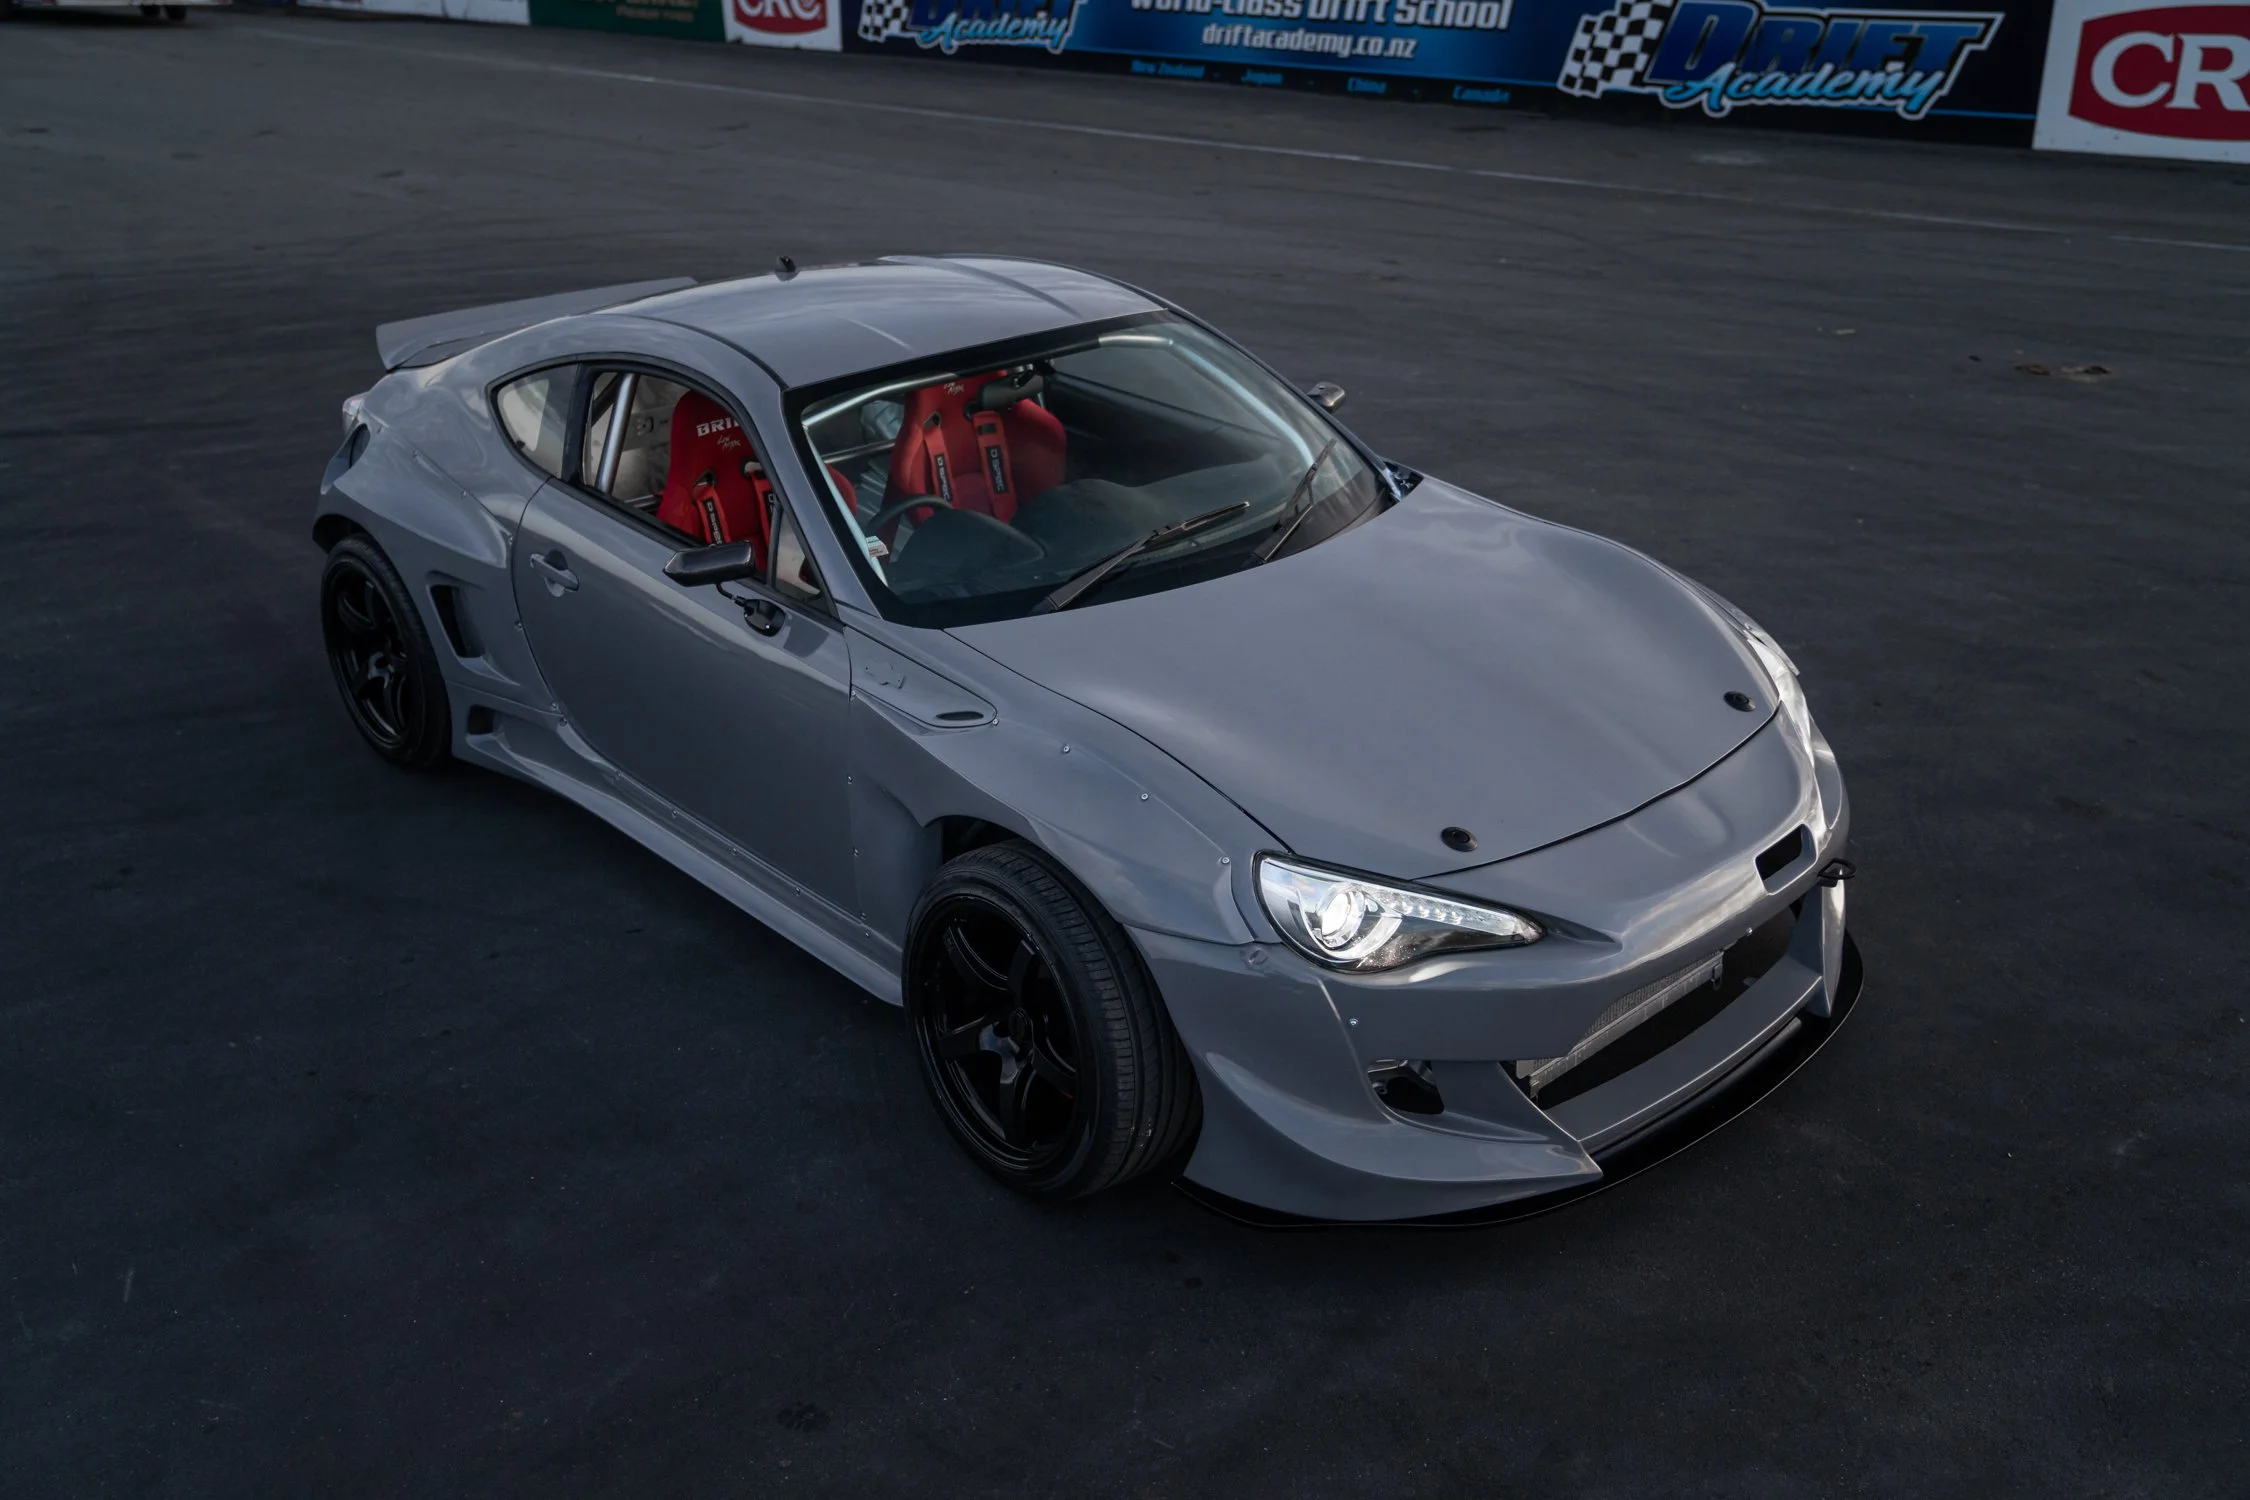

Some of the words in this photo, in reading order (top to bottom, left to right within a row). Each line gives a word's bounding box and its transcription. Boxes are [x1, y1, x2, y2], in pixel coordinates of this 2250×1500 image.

[917, 11, 1068, 49] Academy
[1393, 0, 1514, 30] School
[1201, 22, 1418, 60] driftacademy.co.nz
[1645, 0, 1988, 82] DRIFT
[1664, 62, 1947, 114] Academy
[2090, 31, 2250, 112] CR
